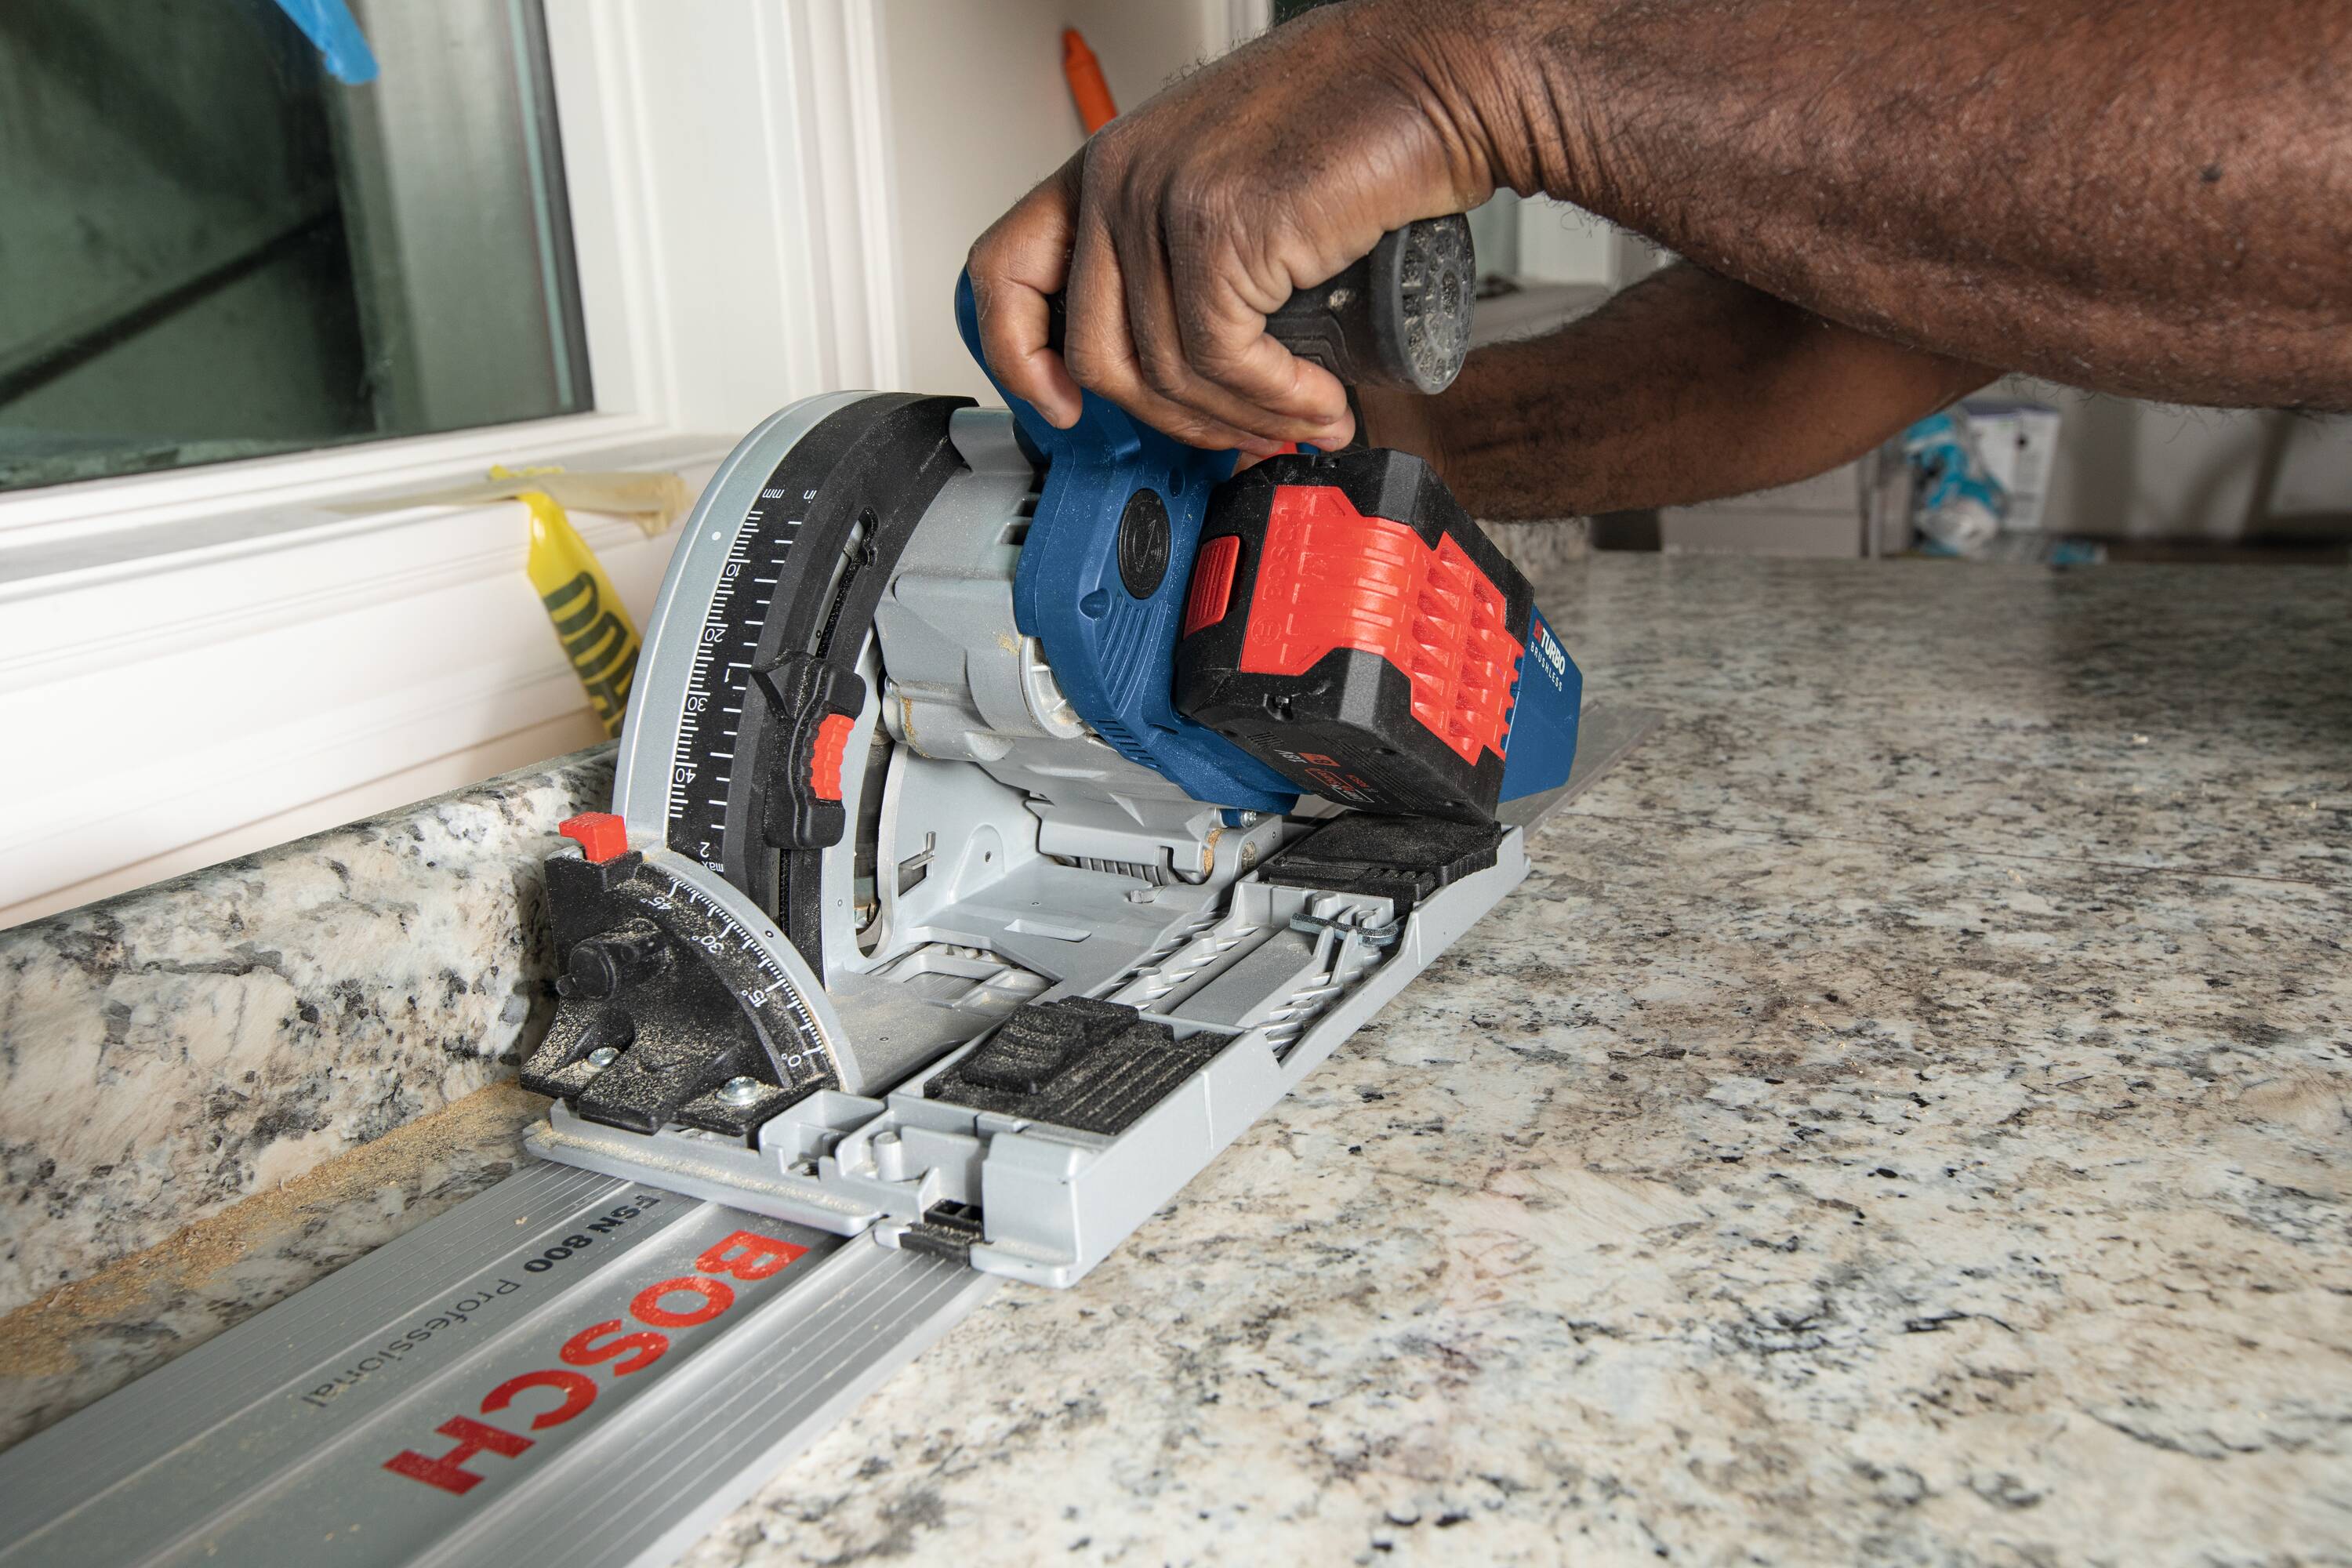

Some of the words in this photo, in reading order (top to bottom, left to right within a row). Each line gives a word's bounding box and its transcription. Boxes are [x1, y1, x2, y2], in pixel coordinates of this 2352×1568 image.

[762, 489, 784, 499] mm
[803, 490, 817, 503] in
[726, 564, 741, 577] 10
[705, 628, 726, 642] 20
[1530, 641, 1563, 691] BRUSHLESS
[724, 668, 730, 683] 1
[688, 697, 708, 711] 30
[676, 768, 696, 783] 40
[699, 841, 710, 858] 2
[691, 935, 724, 953] 30°
[742, 989, 768, 1007] 15°
[781, 1053, 801, 1067] 0°
[586, 1194, 661, 1234] FSN
[523, 1234, 593, 1272] 800
[300, 1279, 521, 1408] Professional
[381, 1229, 811, 1497] BOSCH
